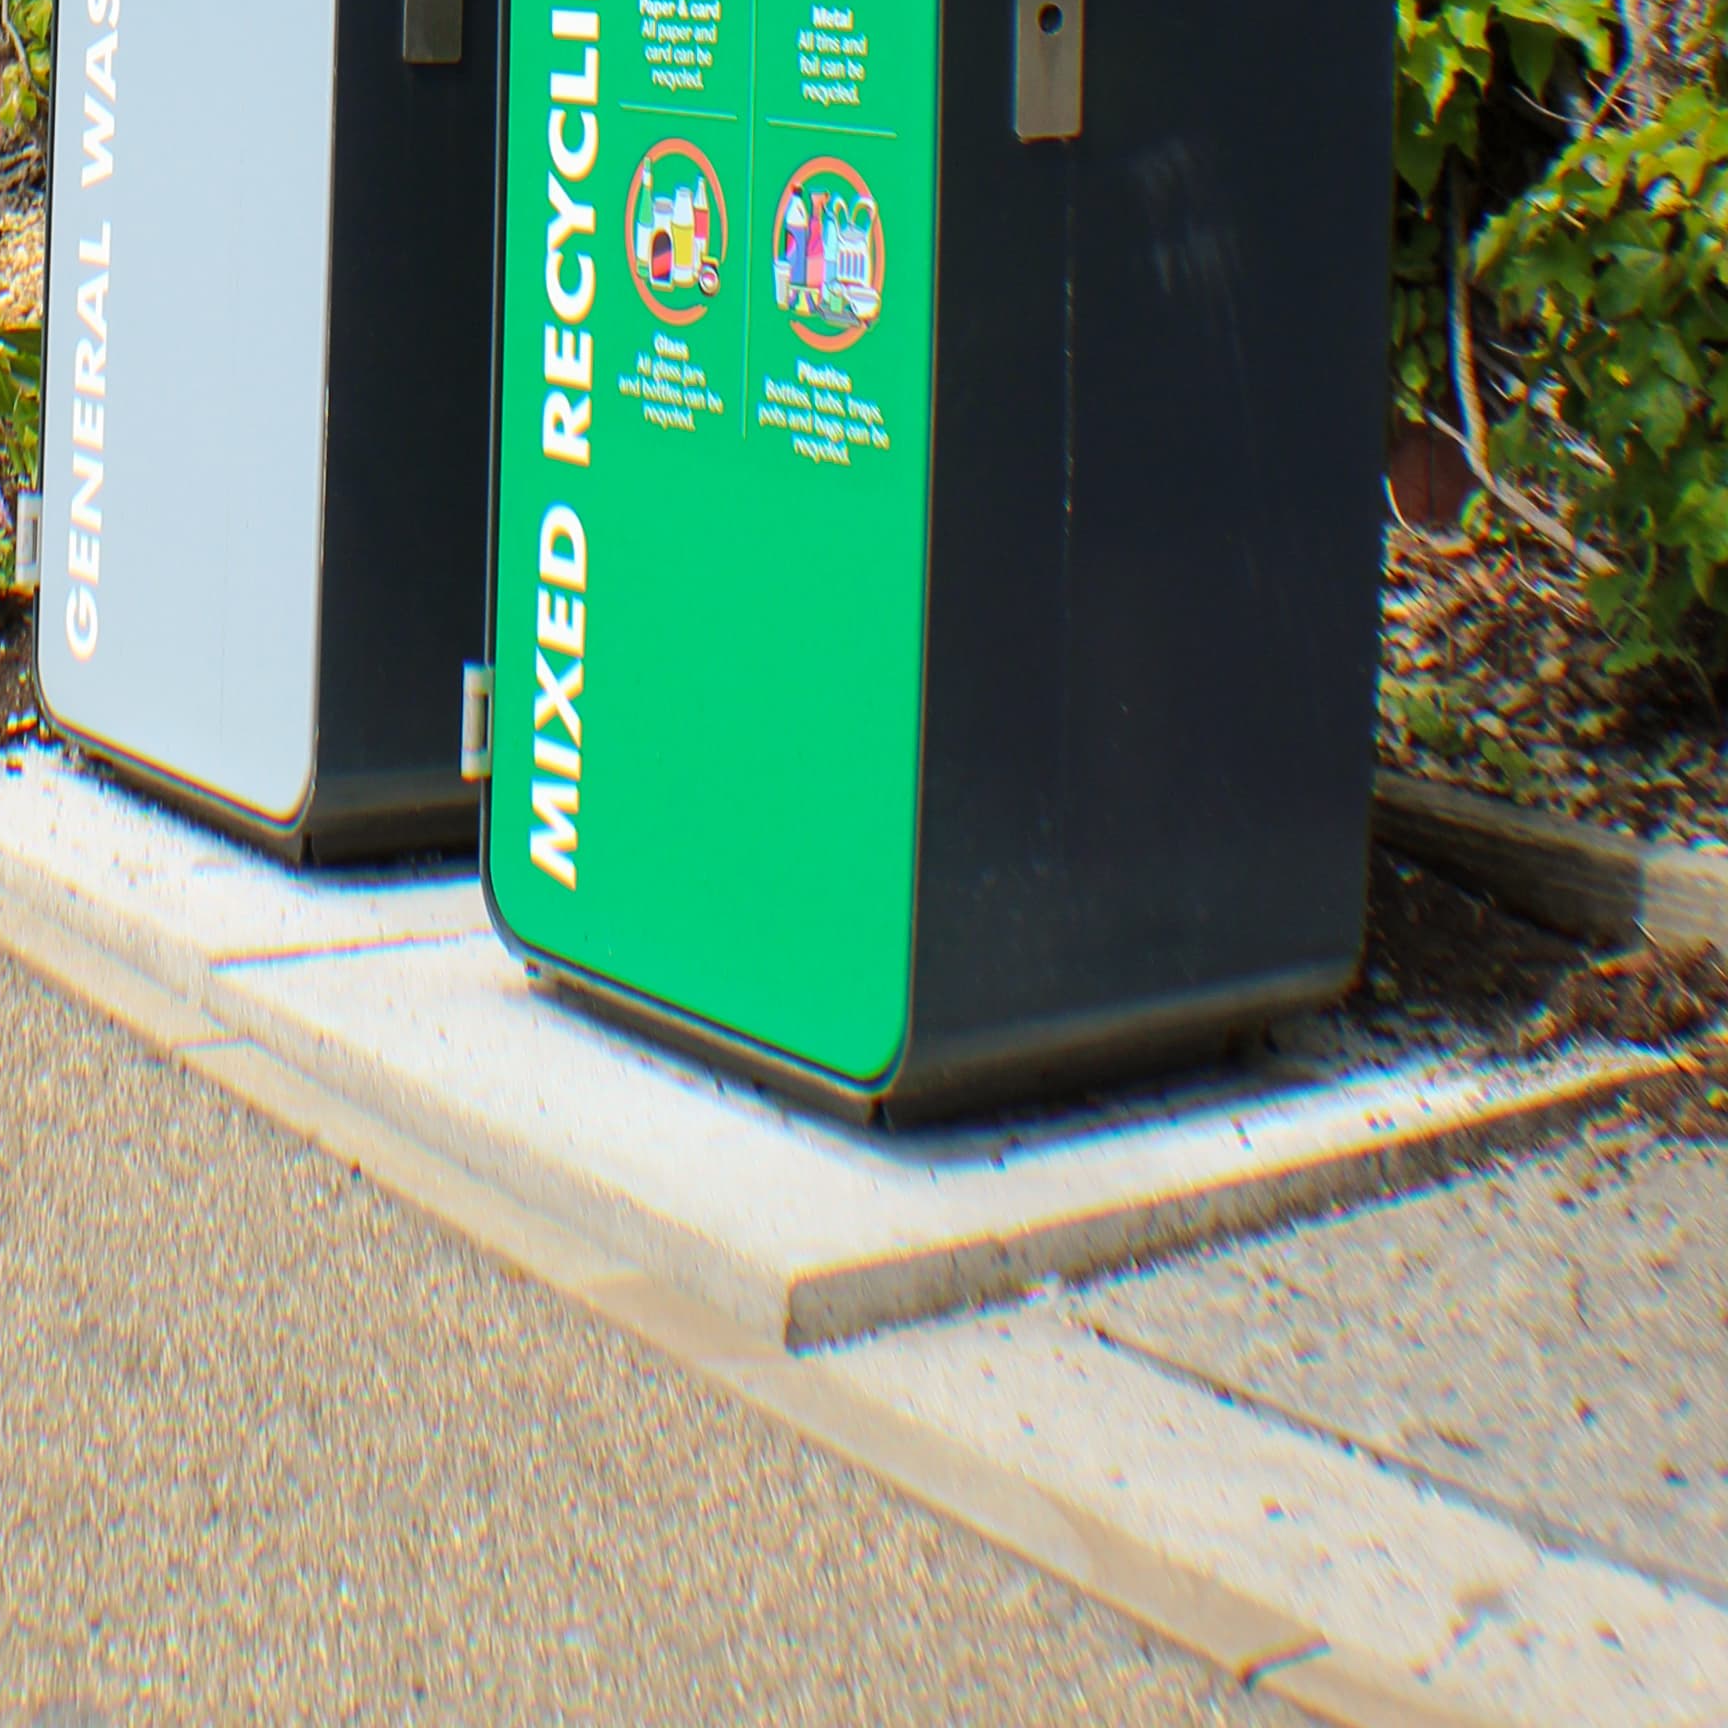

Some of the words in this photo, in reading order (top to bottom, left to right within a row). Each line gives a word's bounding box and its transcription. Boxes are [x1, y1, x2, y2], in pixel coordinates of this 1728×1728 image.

[690, 0, 721, 21] card
[812, 4, 854, 32] Metal
[641, 18, 656, 40] All
[657, 23, 692, 45] paper
[693, 23, 718, 45] and
[798, 28, 814, 51] All
[815, 30, 840, 55] tins
[841, 33, 868, 57] and
[644, 43, 673, 64] card
[673, 48, 696, 66] can
[696, 44, 713, 68] be
[799, 51, 820, 77] foil
[821, 59, 846, 79] can
[847, 56, 866, 82] be
[653, 330, 690, 361] Glass
[636, 352, 652, 377] All
[796, 357, 853, 393] Plastics
[618, 372, 641, 398] and
[642, 374, 683, 406] bottles
[683, 387, 707, 410] can
[706, 387, 724, 414] be
[65, 221, 112, 662] GENERAL
[758, 401, 787, 428] pots
[787, 407, 813, 434] and
[844, 420, 870, 446] can
[870, 424, 891, 451] be
[529, 506, 590, 892] MIXED
